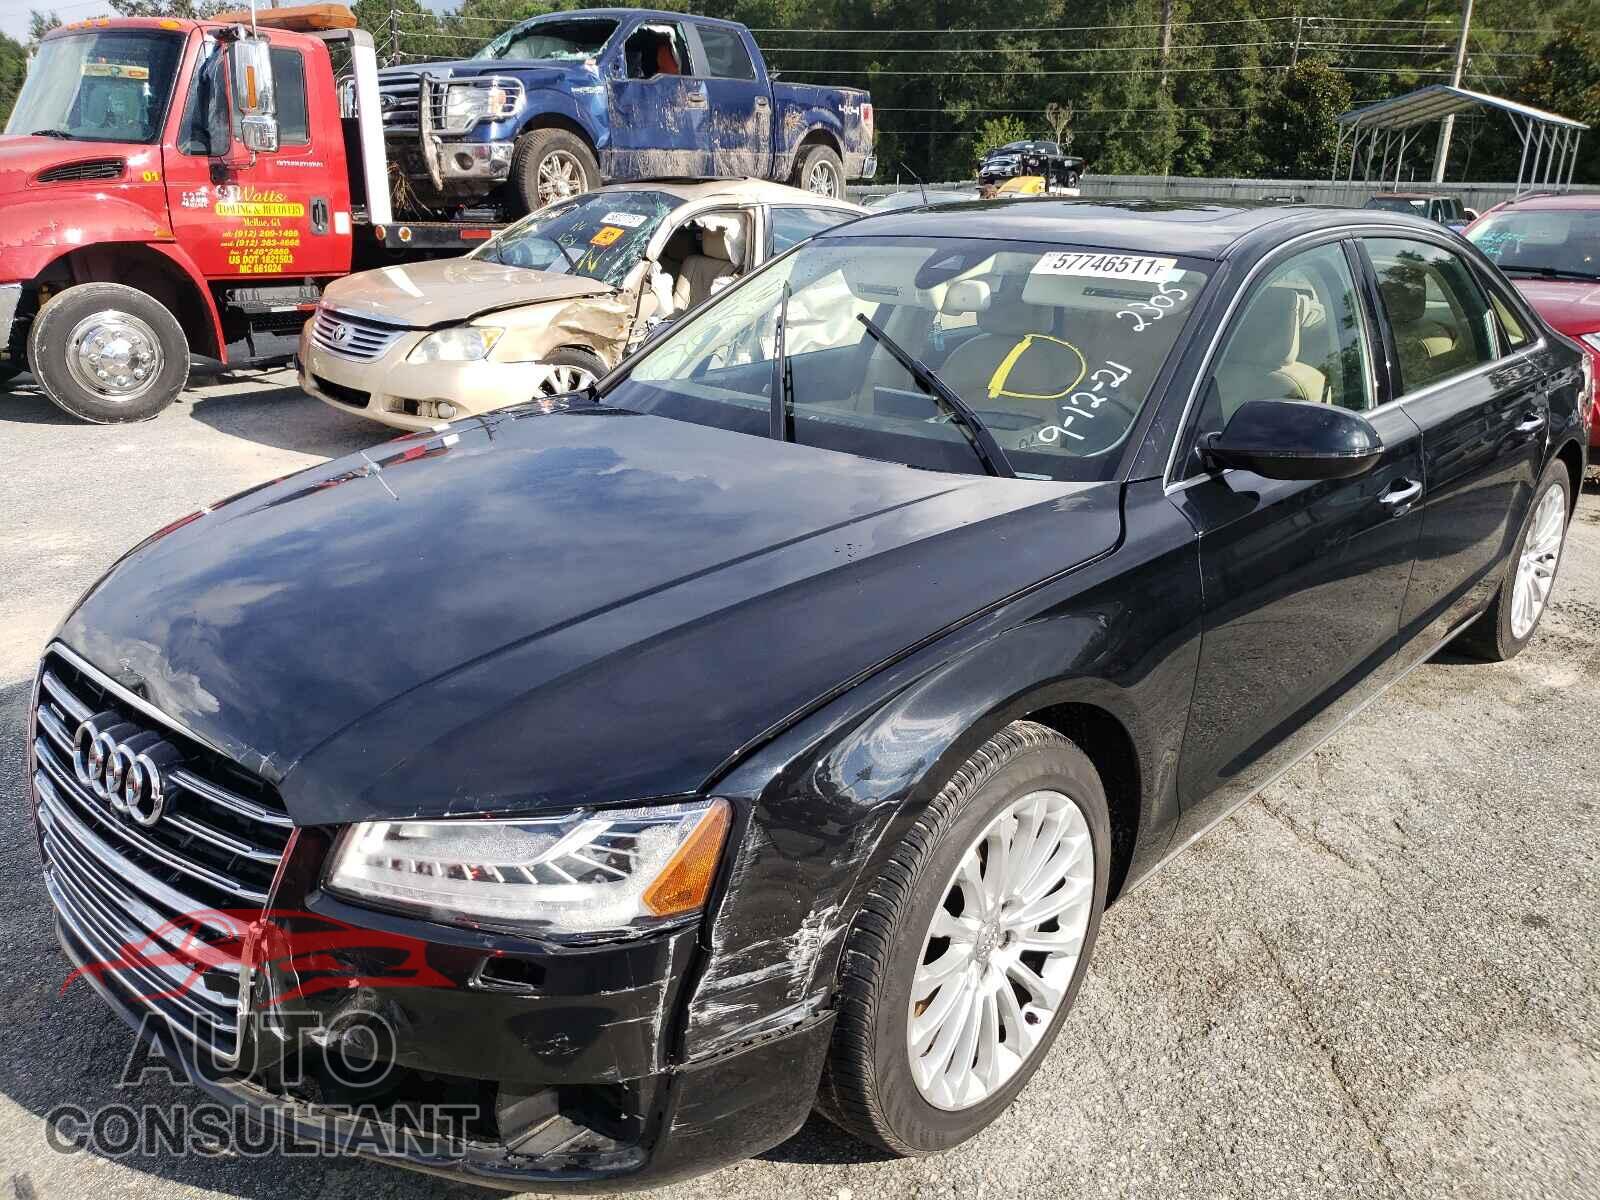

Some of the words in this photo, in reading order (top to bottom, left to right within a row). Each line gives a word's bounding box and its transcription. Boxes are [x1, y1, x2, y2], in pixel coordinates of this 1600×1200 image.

[218, 204, 252, 215] TOWING
[228, 255, 241, 264] US
[242, 255, 260, 264] DOT
[240, 264, 252, 273] MC
[1116, 281, 1188, 332] 2305
[988, 333, 1087, 399] D
[1038, 361, 1132, 441] 9-12-21
